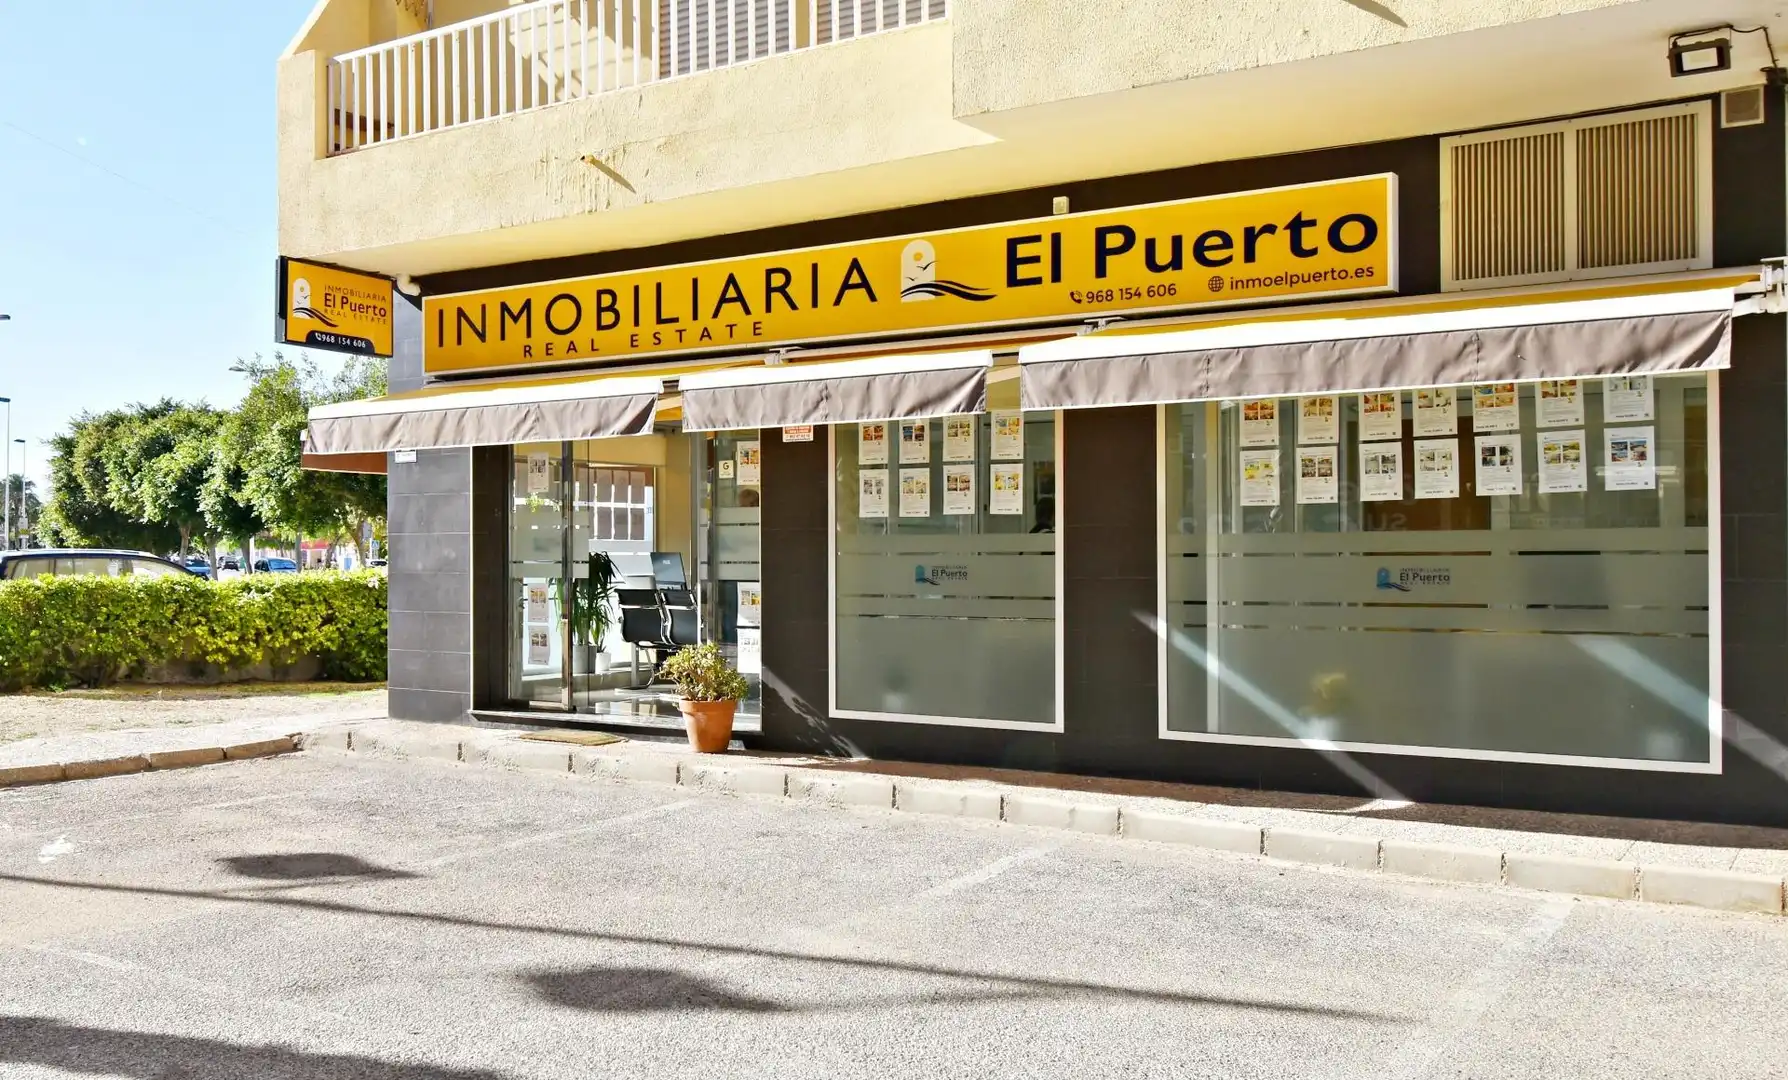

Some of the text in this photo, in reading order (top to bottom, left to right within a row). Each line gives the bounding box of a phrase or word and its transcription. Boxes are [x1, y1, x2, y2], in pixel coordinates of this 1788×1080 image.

[1005, 211, 1379, 288] El Puerto
[1229, 265, 1375, 291] inmoelpuerto.es
[324, 285, 386, 303] INMOBILIARIA
[437, 257, 878, 347] INMOBILIARIA
[1085, 283, 1177, 304] 968 154 606
[324, 293, 386, 318] El Puerto
[324, 308, 386, 325] REAL ESTATE
[321, 333, 366, 348] 968 154 606
[524, 321, 764, 358] REAL ESTATE
[931, 569, 968, 577] El Puerto
[1399, 572, 1451, 582] El Puerto
